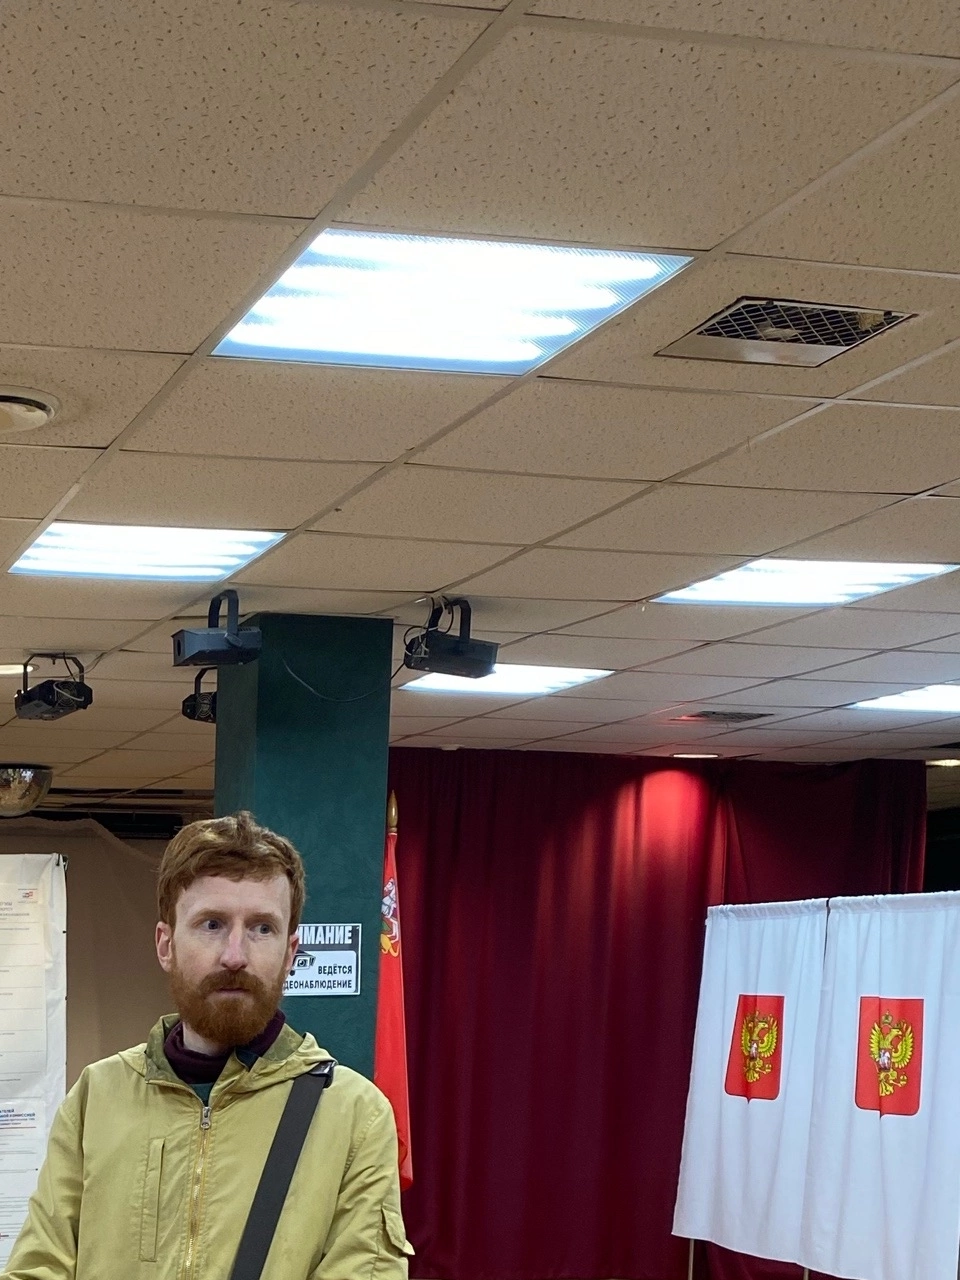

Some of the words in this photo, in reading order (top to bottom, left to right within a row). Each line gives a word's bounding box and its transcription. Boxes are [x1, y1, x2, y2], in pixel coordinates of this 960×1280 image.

[298, 926, 351, 944] ИМАНИЕ
[318, 964, 352, 976] ВЕДЁТСЯ
[284, 980, 352, 990] ДЕОНАБЛЮДЕНИЕ
